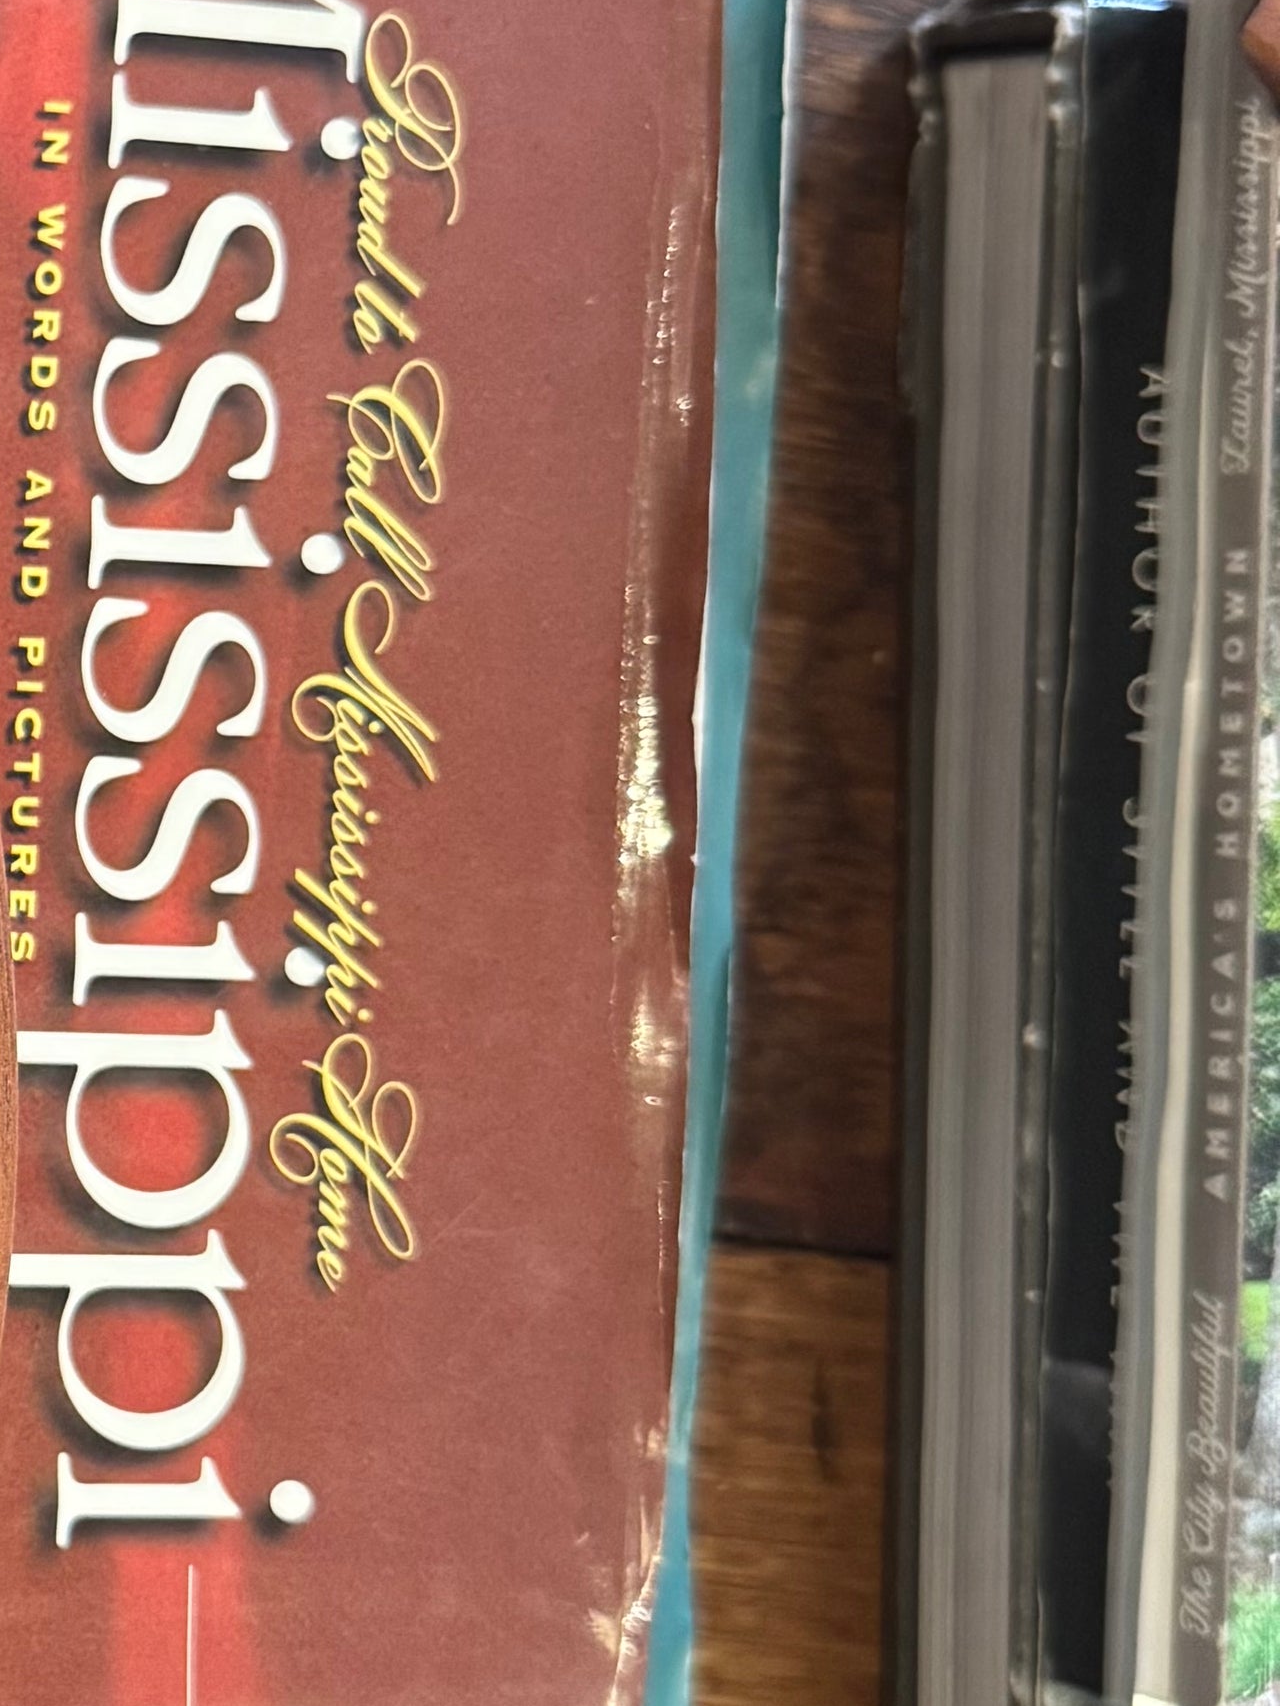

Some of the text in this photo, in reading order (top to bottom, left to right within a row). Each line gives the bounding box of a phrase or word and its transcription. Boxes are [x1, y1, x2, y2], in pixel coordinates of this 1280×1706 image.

[10, 99, 75, 962] IN WORDS AND PICTURES
[268, 9, 462, 1295] Proud to Call Mississippi Home
[1179, 98, 1272, 1639] The City Beautiful AMERICA'S HOMETOWN Laurel, Mississippi
